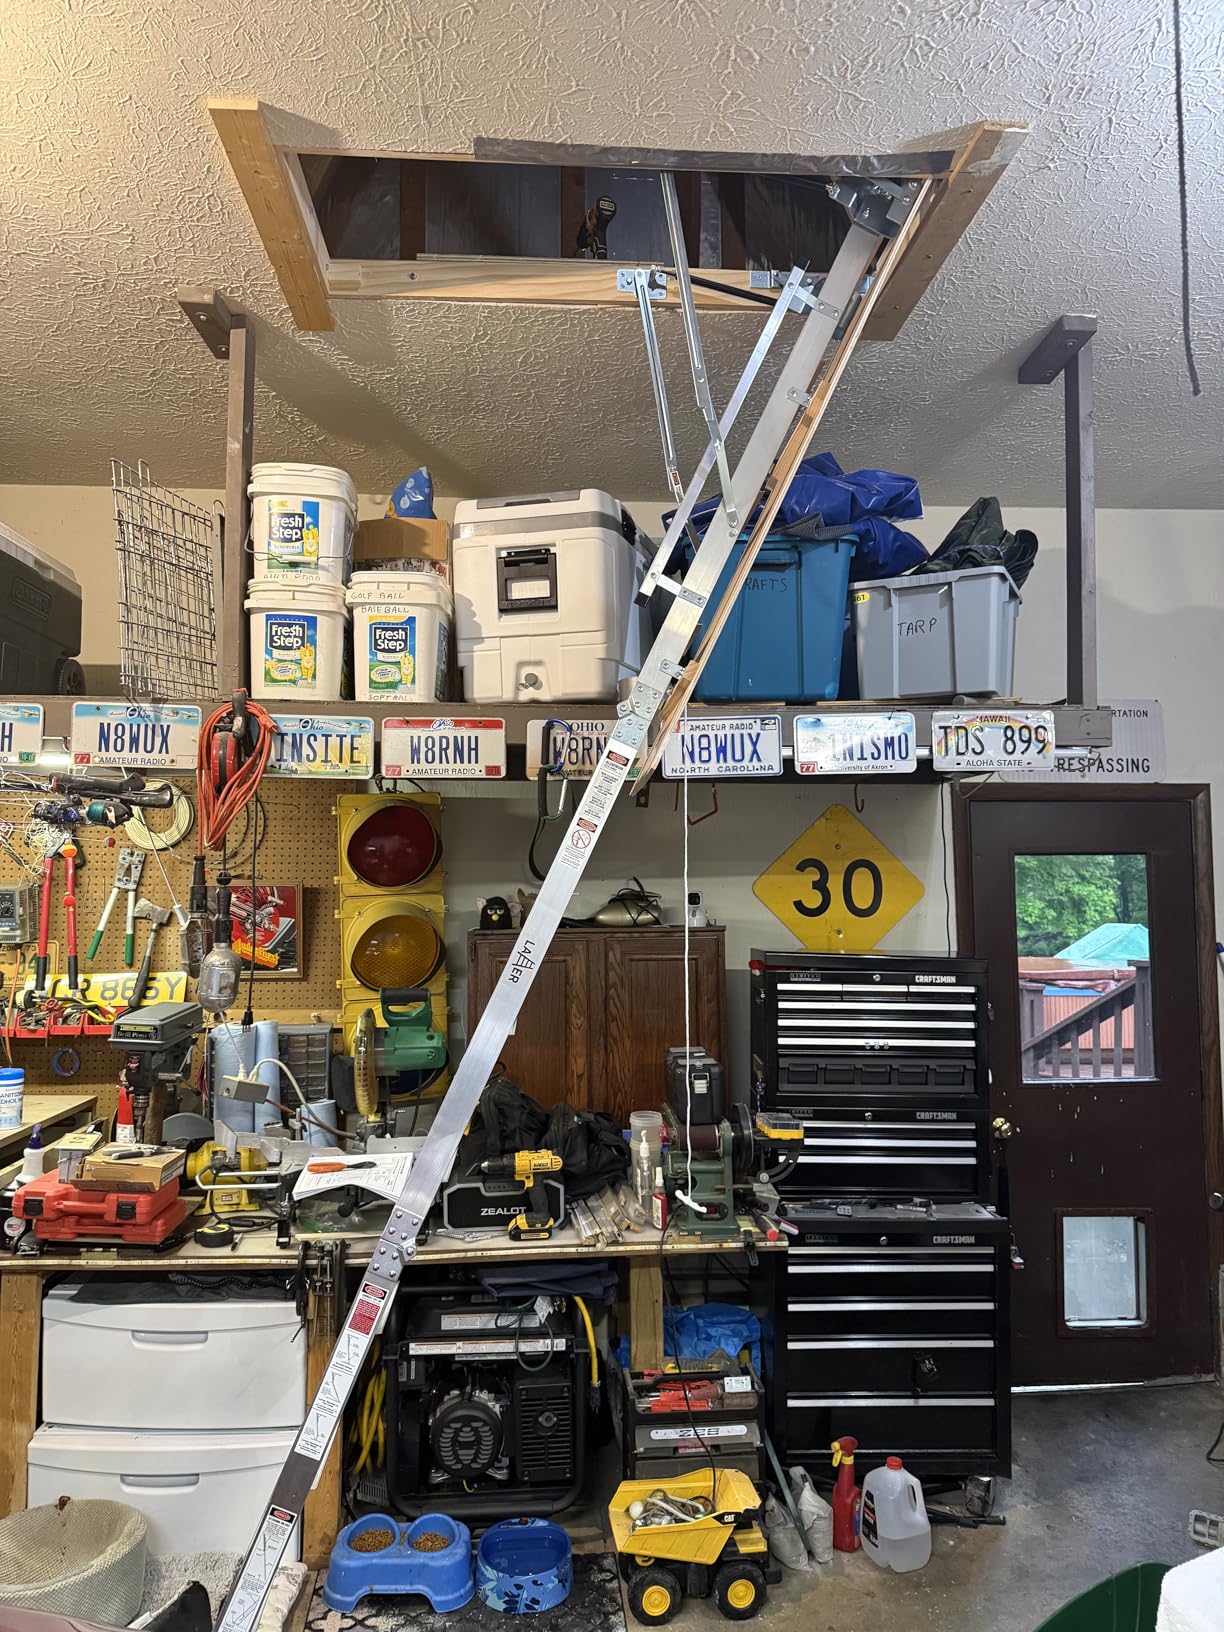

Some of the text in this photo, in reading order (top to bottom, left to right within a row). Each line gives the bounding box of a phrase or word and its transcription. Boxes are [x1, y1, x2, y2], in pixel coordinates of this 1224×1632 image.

[271, 515, 302, 528] Fresh
[272, 527, 301, 541] Step
[350, 592, 405, 600] GOLF BALL
[854, 594, 865, 602] 61
[271, 624, 303, 637] Fresh
[897, 617, 937, 637] TARP
[375, 629, 406, 640] Fresh
[272, 635, 302, 649] Step
[376, 639, 405, 652] Step
[1112, 709, 1149, 718] RTATION
[571, 721, 605, 732] OHIO
[689, 722, 754, 731] AMATEUR RADIO
[98, 722, 171, 754] N8WUX
[938, 724, 1048, 756] TDS 899
[276, 732, 362, 764] INSITE
[410, 735, 479, 764] W8RNH
[681, 732, 762, 764] N8WUX
[76, 755, 167, 765] 77 AMATEUR RADIO
[966, 759, 1023, 767] ALOHA STATE
[1051, 757, 1150, 773] RESPASSING
[386, 766, 400, 775] 77
[717, 764, 774, 773] CAROLINA
[801, 763, 816, 772] 77
[793, 858, 883, 918] 30
[915, 975, 956, 984] CRAFTSMAN
[916, 1111, 957, 1120] CRAFTSMAN
[480, 1206, 527, 1216] ZEALOT
[933, 1235, 976, 1244] CRAFTSMAN
[724, 1514, 735, 1522] CAT
